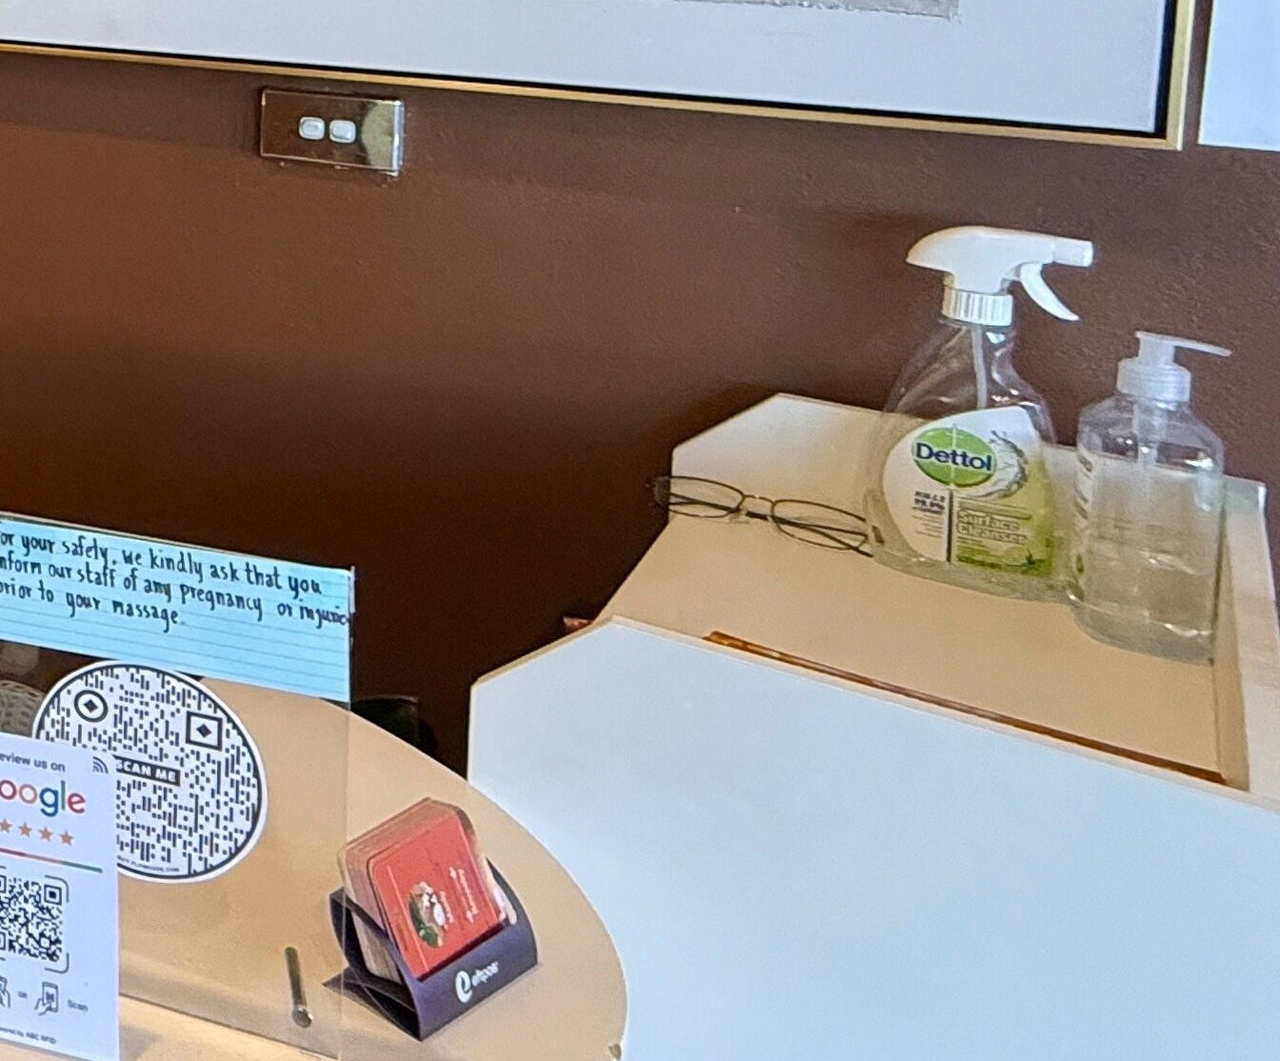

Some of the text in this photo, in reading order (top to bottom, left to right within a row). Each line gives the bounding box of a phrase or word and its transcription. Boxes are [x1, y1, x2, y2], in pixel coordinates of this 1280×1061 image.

[915, 441, 993, 472] Dettol
[957, 508, 1022, 532] Surface
[957, 522, 1028, 545] Cleanser
[21, 535, 56, 557] your
[122, 548, 143, 566] we
[149, 547, 203, 584] kindly
[210, 562, 240, 582] ask
[244, 562, 283, 590] that
[288, 574, 323, 600] you
[38, 579, 55, 603] to
[66, 591, 101, 618] your
[48, 563, 72, 579] our
[77, 561, 117, 588] staff
[123, 567, 139, 592] of
[143, 578, 172, 603] any
[179, 583, 263, 622] pregnancy
[277, 602, 294, 617] or
[34, 757, 49, 770] us
[50, 760, 66, 773] on
[155, 768, 177, 784] ME
[67, 999, 90, 1012] Scan
